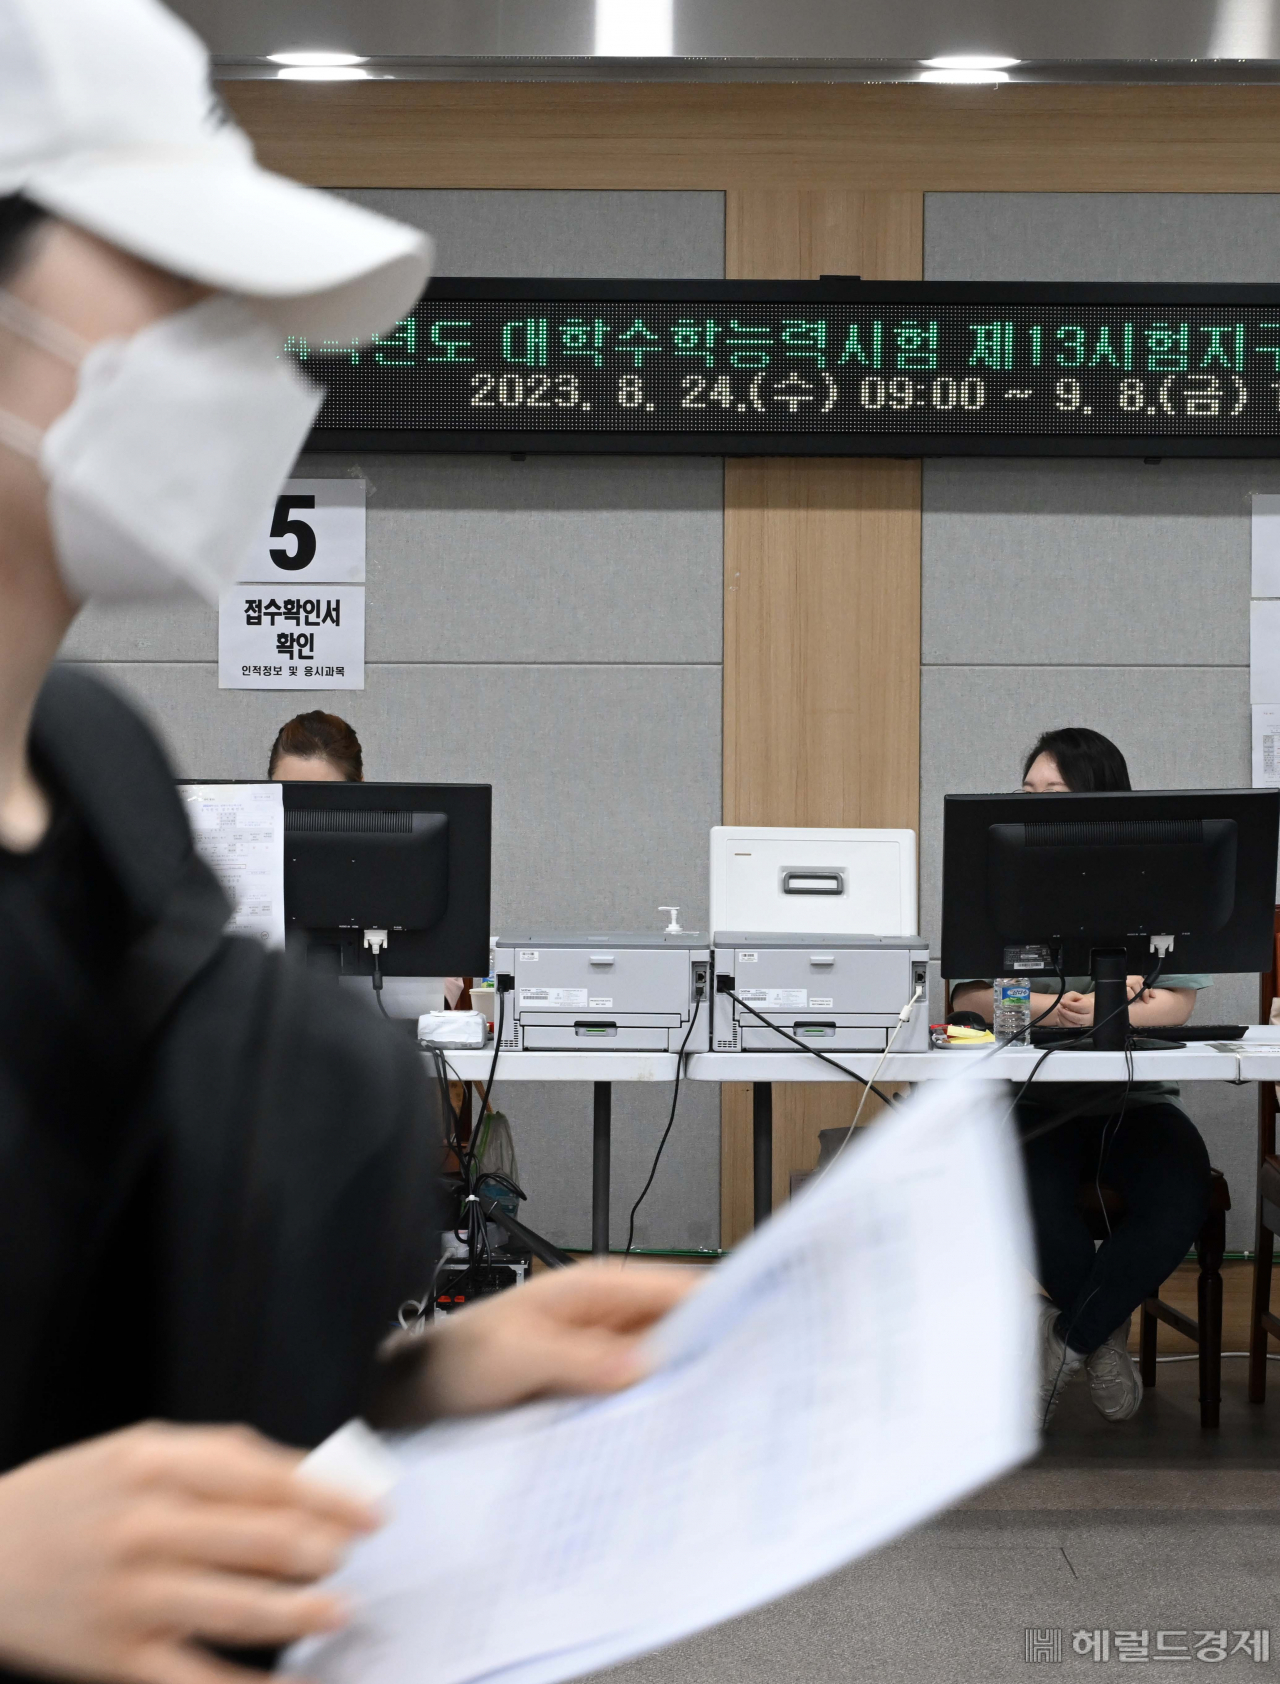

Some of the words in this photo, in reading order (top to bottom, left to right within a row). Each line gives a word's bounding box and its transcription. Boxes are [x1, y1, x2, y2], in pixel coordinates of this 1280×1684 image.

[502, 318, 938, 369] 대학수학능력시험
[471, 373, 592, 411] 2023.
[618, 375, 655, 411] 8.
[681, 372, 838, 412] 24.(수)
[860, 376, 985, 410] 09:00
[1056, 378, 1092, 414] 9.
[1119, 375, 1247, 416] 8.(금)
[269, 495, 316, 571] 5
[244, 599, 340, 626] 접수확인서
[276, 632, 314, 660] 확인
[241, 665, 283, 677] 인적정보
[288, 665, 298, 677] 및
[304, 666, 345, 677] 응시과목
